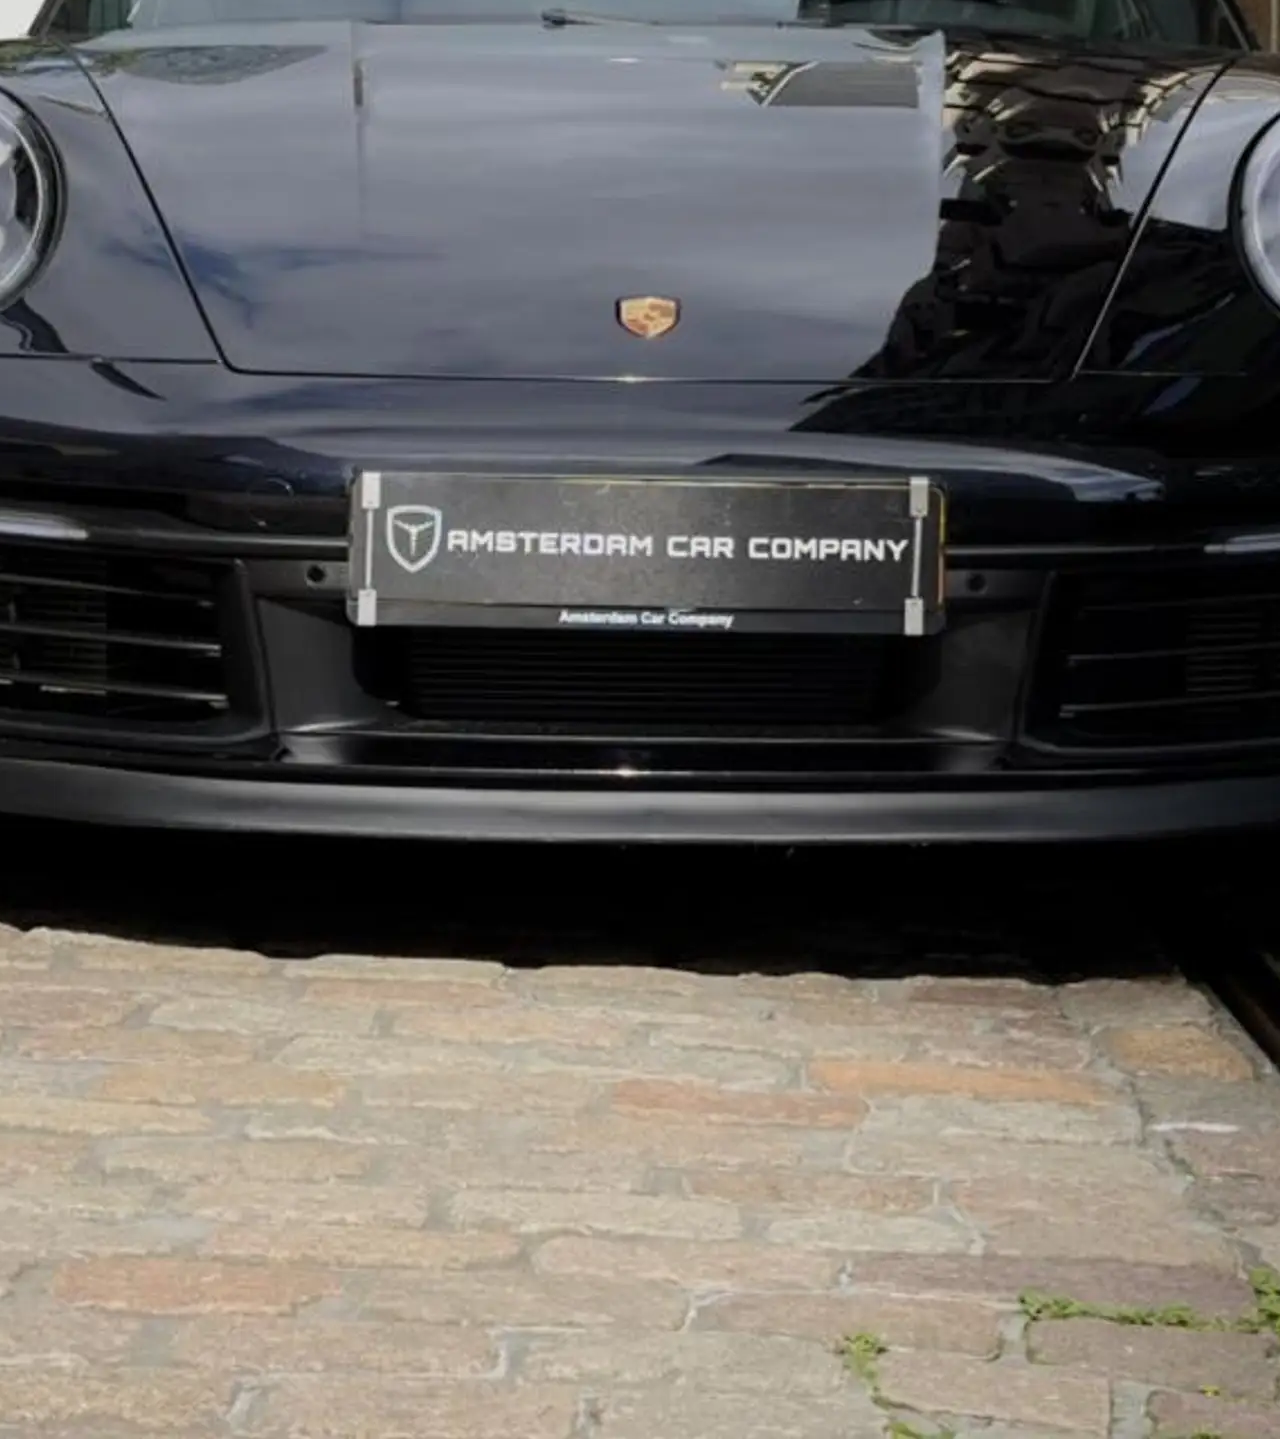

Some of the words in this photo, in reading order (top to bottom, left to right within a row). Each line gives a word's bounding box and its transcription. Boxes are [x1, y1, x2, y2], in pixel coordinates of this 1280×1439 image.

[446, 528, 654, 557] AMSTERDAM
[666, 535, 735, 559] CAR
[748, 536, 910, 562] COMPANY
[558, 608, 638, 626] Amsterdam
[640, 611, 666, 626] Car
[668, 611, 735, 631] Company
